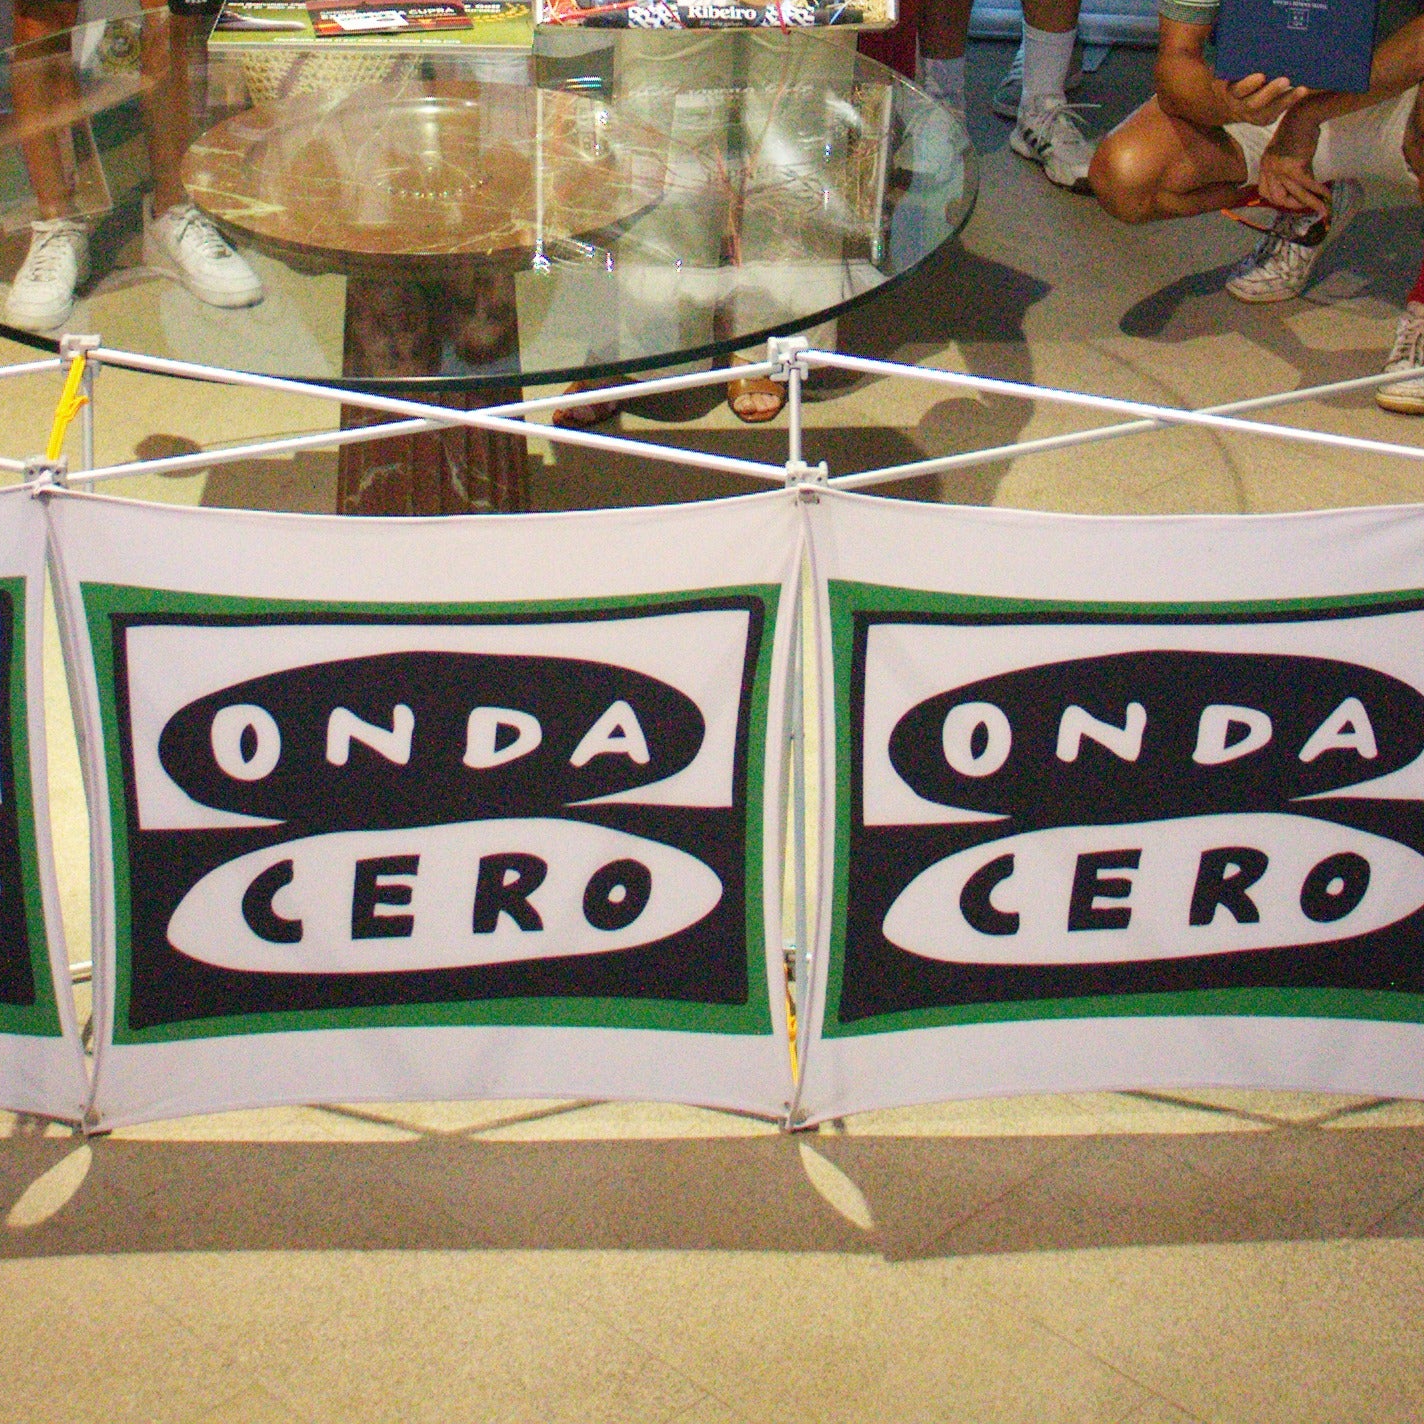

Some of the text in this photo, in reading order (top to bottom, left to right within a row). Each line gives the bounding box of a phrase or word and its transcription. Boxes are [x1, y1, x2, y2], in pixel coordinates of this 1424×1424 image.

[687, 5, 757, 21] Ribeiro
[210, 698, 672, 781] ONDA
[941, 696, 1379, 778] ONDA
[241, 854, 653, 946] CERO
[958, 847, 1372, 937] CERO
